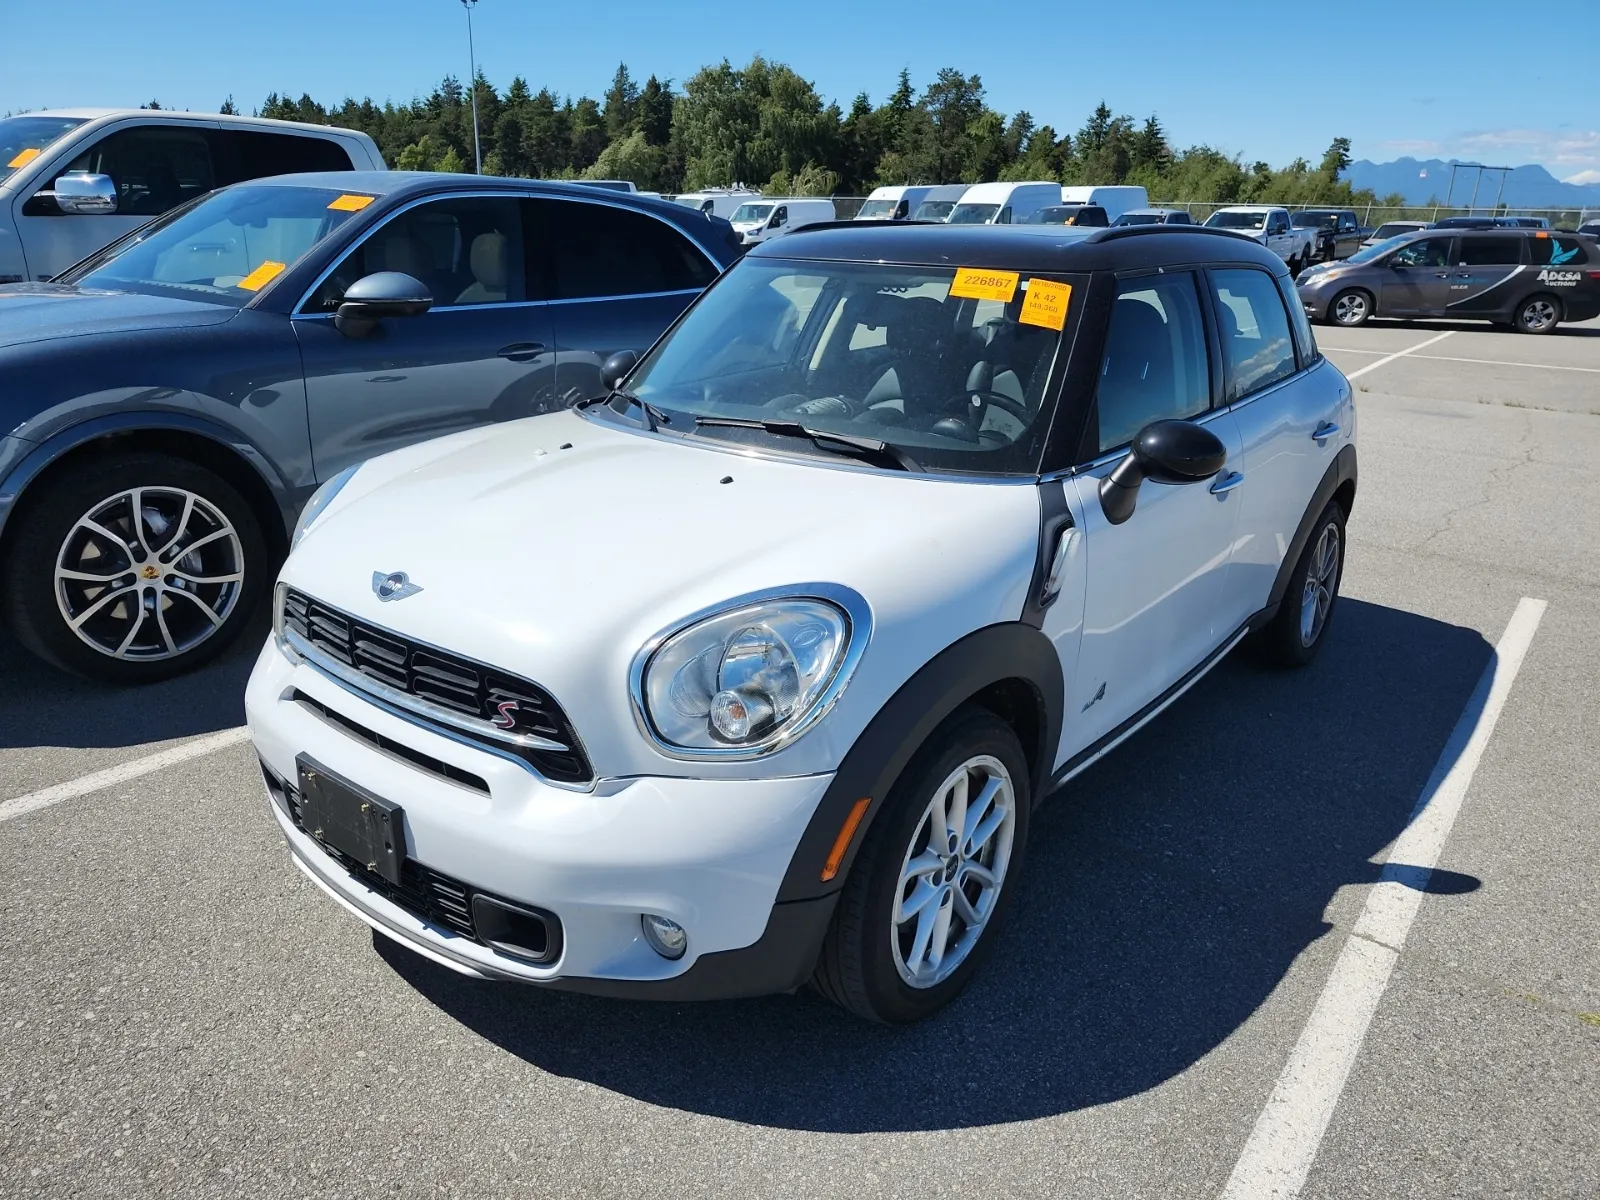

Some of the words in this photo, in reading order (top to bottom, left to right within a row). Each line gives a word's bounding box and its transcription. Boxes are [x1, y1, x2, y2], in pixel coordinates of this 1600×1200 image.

[1536, 269, 1582, 281] ADESA
[964, 275, 1012, 288] 226867
[1033, 292, 1041, 300] K
[1043, 294, 1057, 303] 42
[490, 700, 520, 729] S
